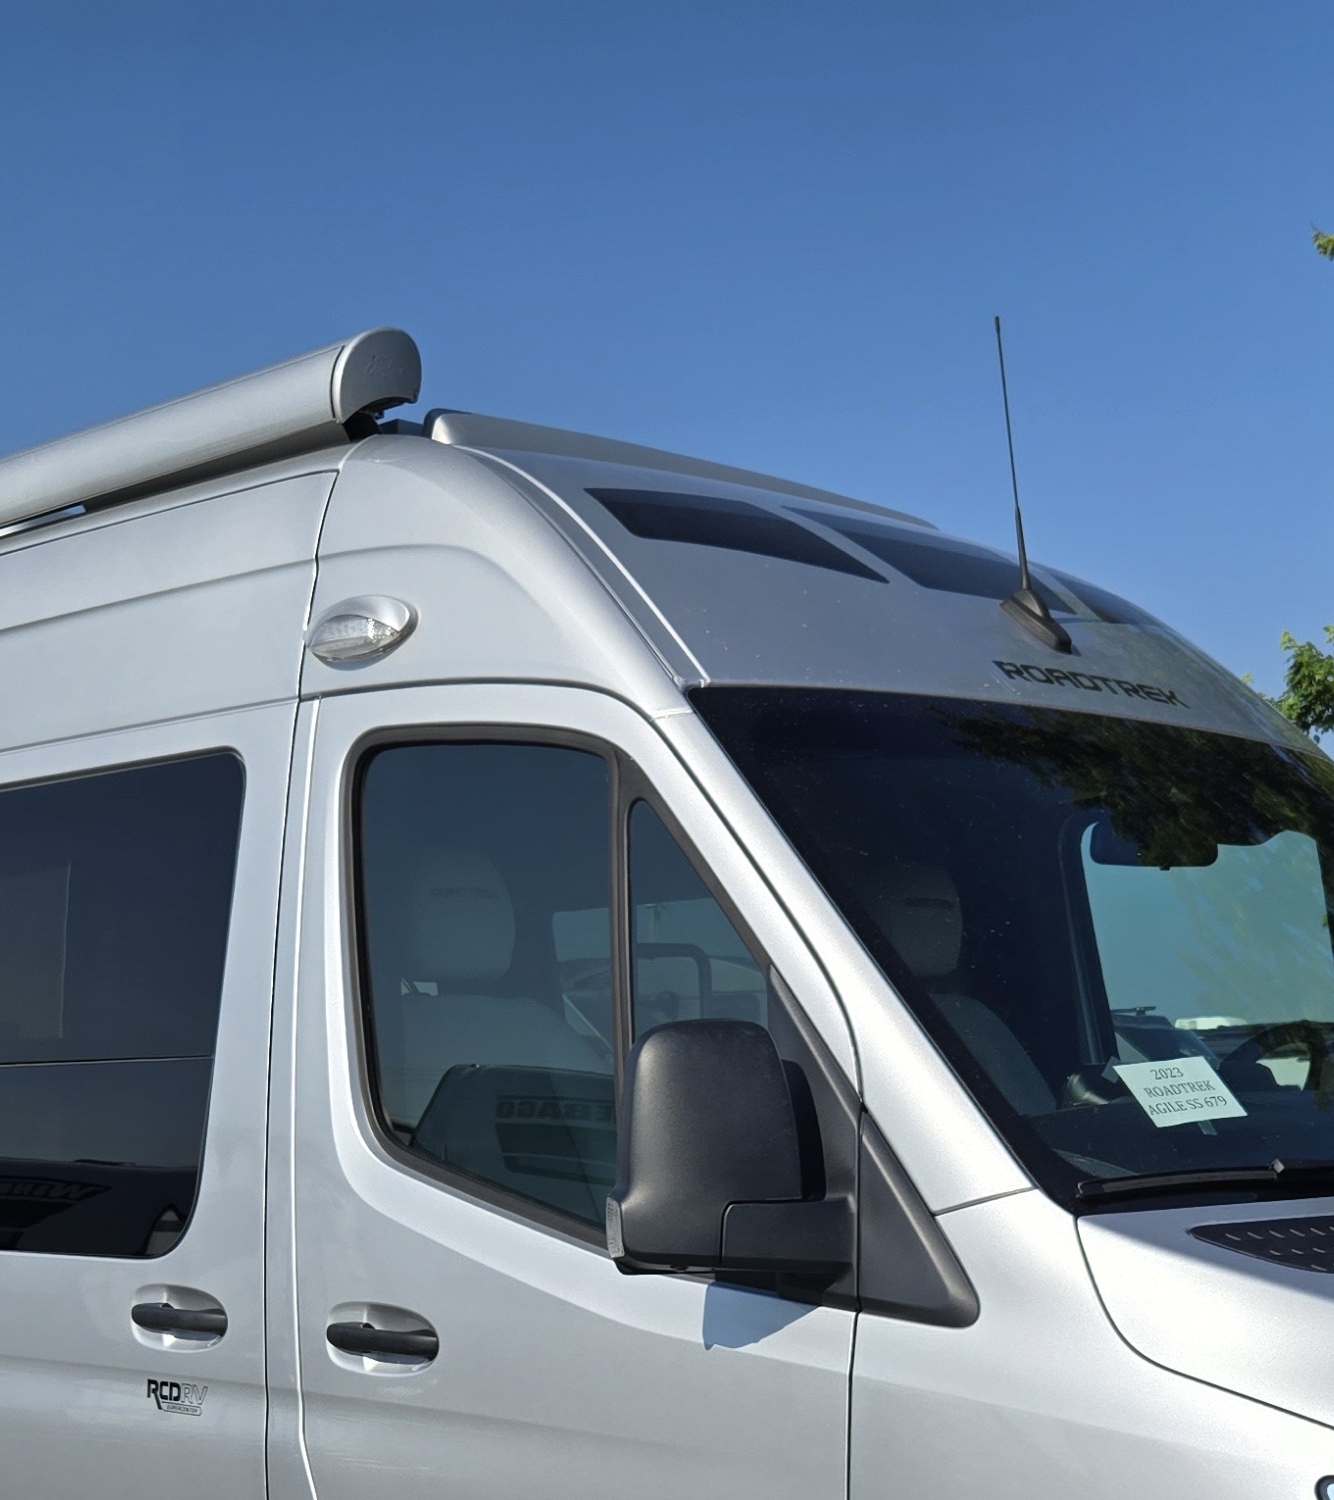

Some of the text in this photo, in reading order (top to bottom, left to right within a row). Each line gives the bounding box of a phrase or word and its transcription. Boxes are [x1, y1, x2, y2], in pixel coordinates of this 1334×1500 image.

[992, 660, 1191, 709] ROADTREK
[1150, 1067, 1184, 1080] 2023
[1143, 1080, 1215, 1098] ROADTREK
[1148, 1095, 1227, 1115] AGILE SS 679
